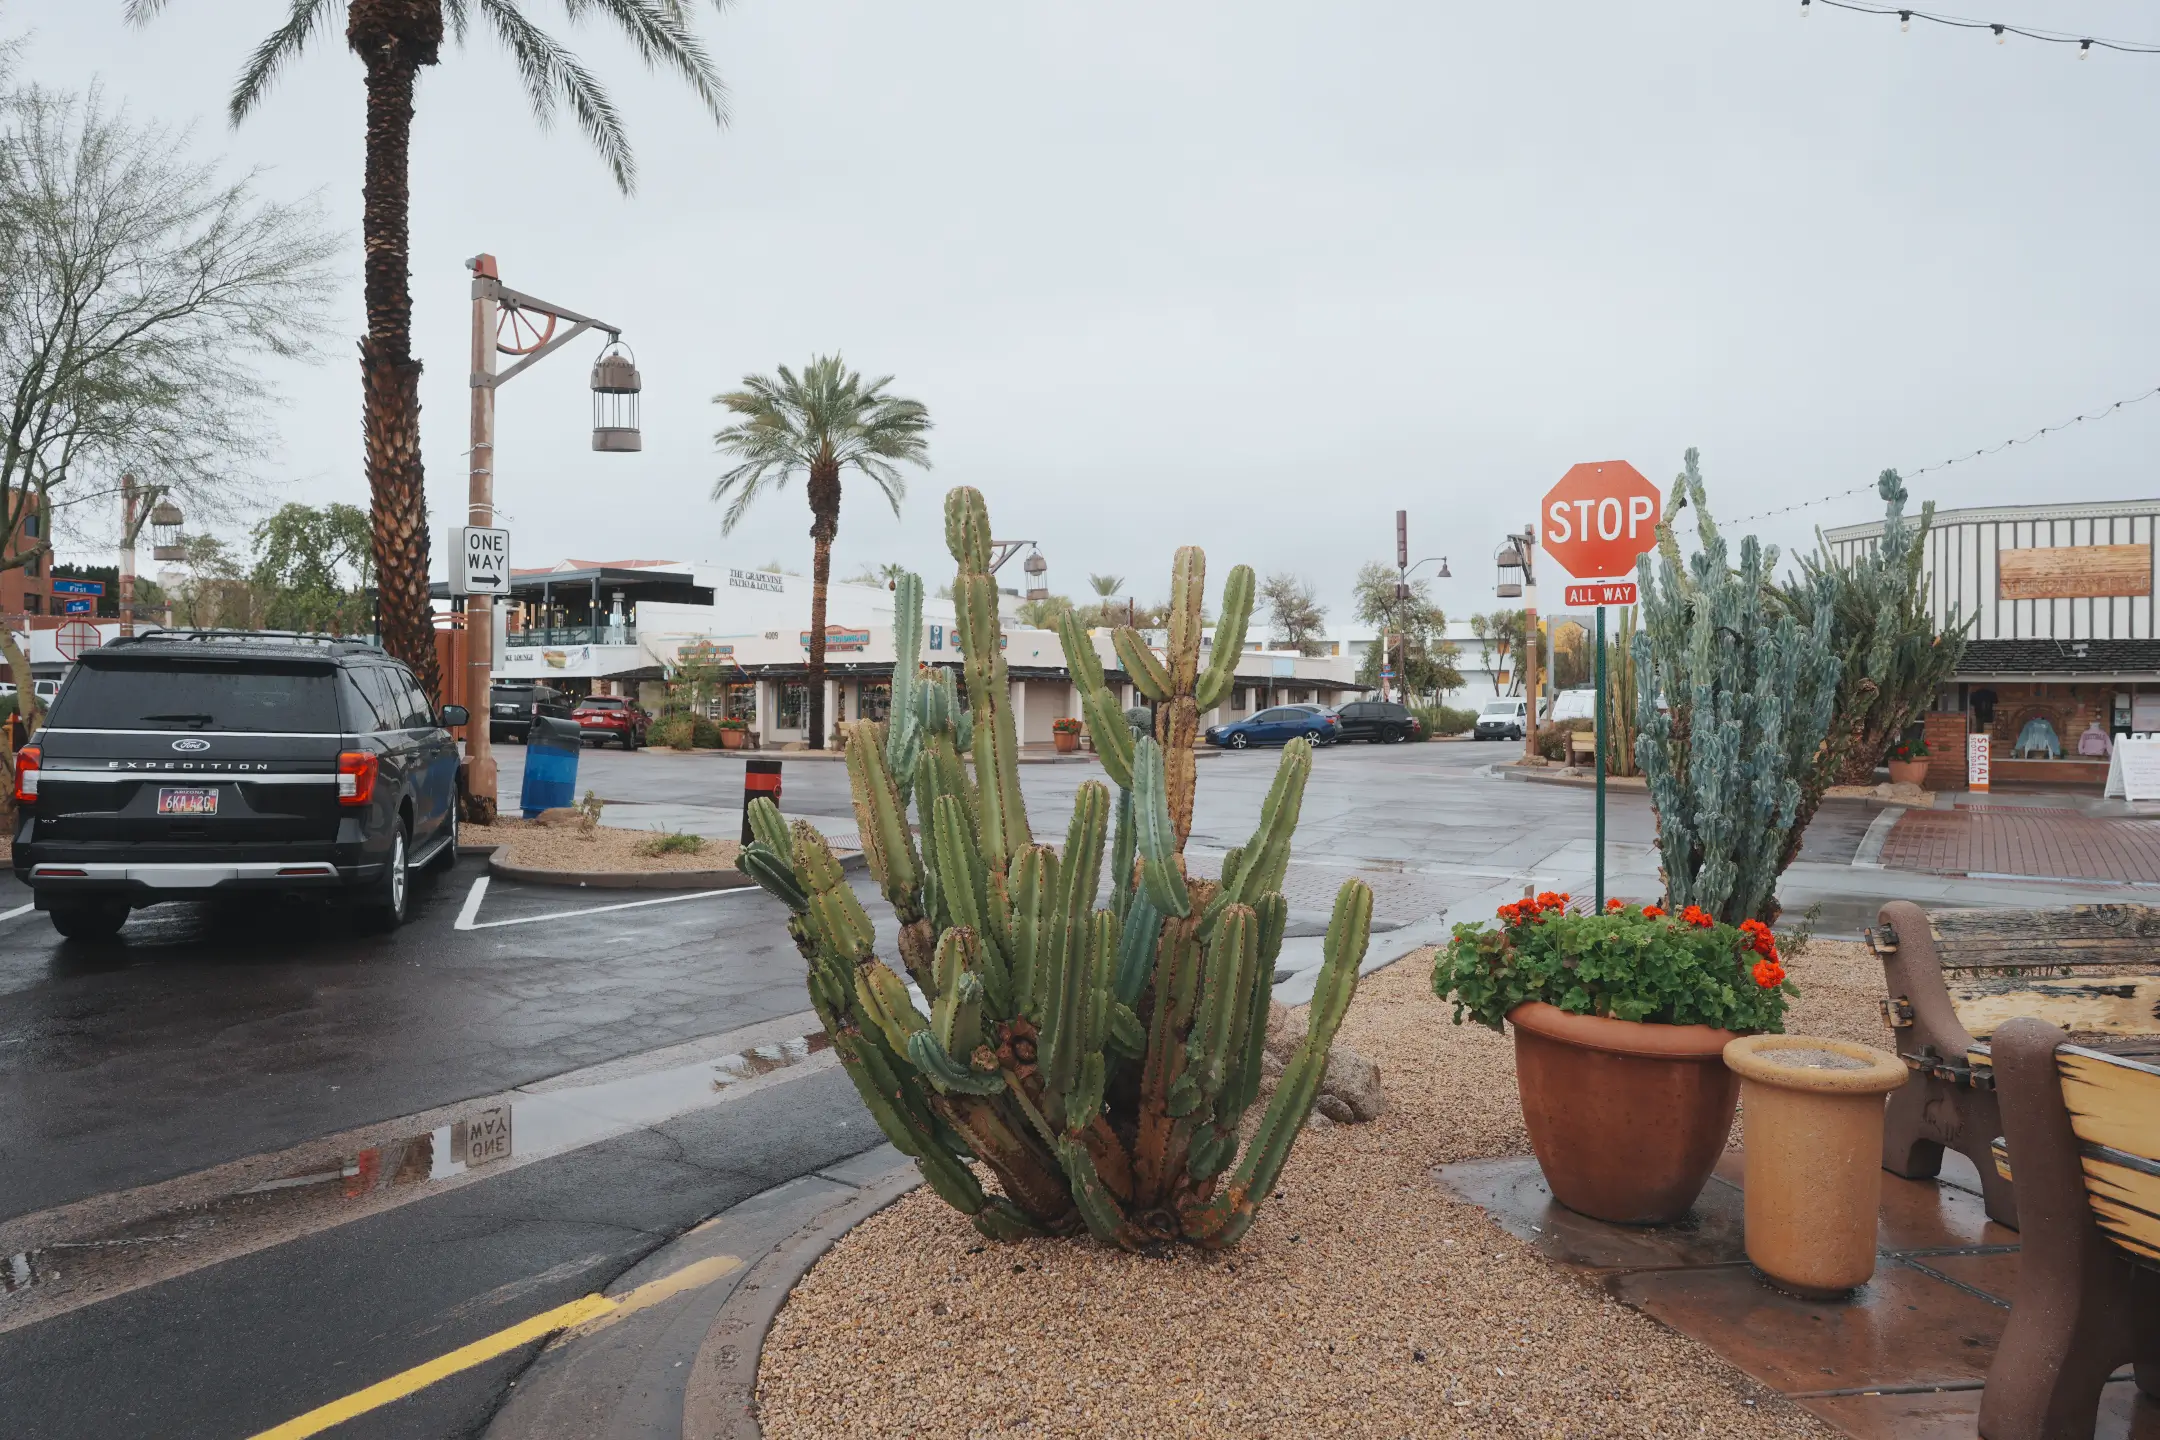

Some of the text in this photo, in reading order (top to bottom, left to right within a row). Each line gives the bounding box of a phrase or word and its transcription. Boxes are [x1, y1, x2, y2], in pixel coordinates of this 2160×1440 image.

[1549, 496, 1653, 543] STOP
[470, 534, 502, 551] ONE
[468, 553, 504, 570] WAY
[730, 568, 783, 585] THE GRAPEVINE
[69, 585, 87, 593] First
[729, 577, 784, 593] PATIO & LOUNGE
[1570, 586, 1631, 603] ALL WAY
[764, 631, 779, 640] 4009
[514, 653, 534, 661] LOUNGE
[180, 741, 202, 749] Ford
[108, 761, 268, 770] EXPEDITION
[1977, 737, 1988, 782] SOCIAL
